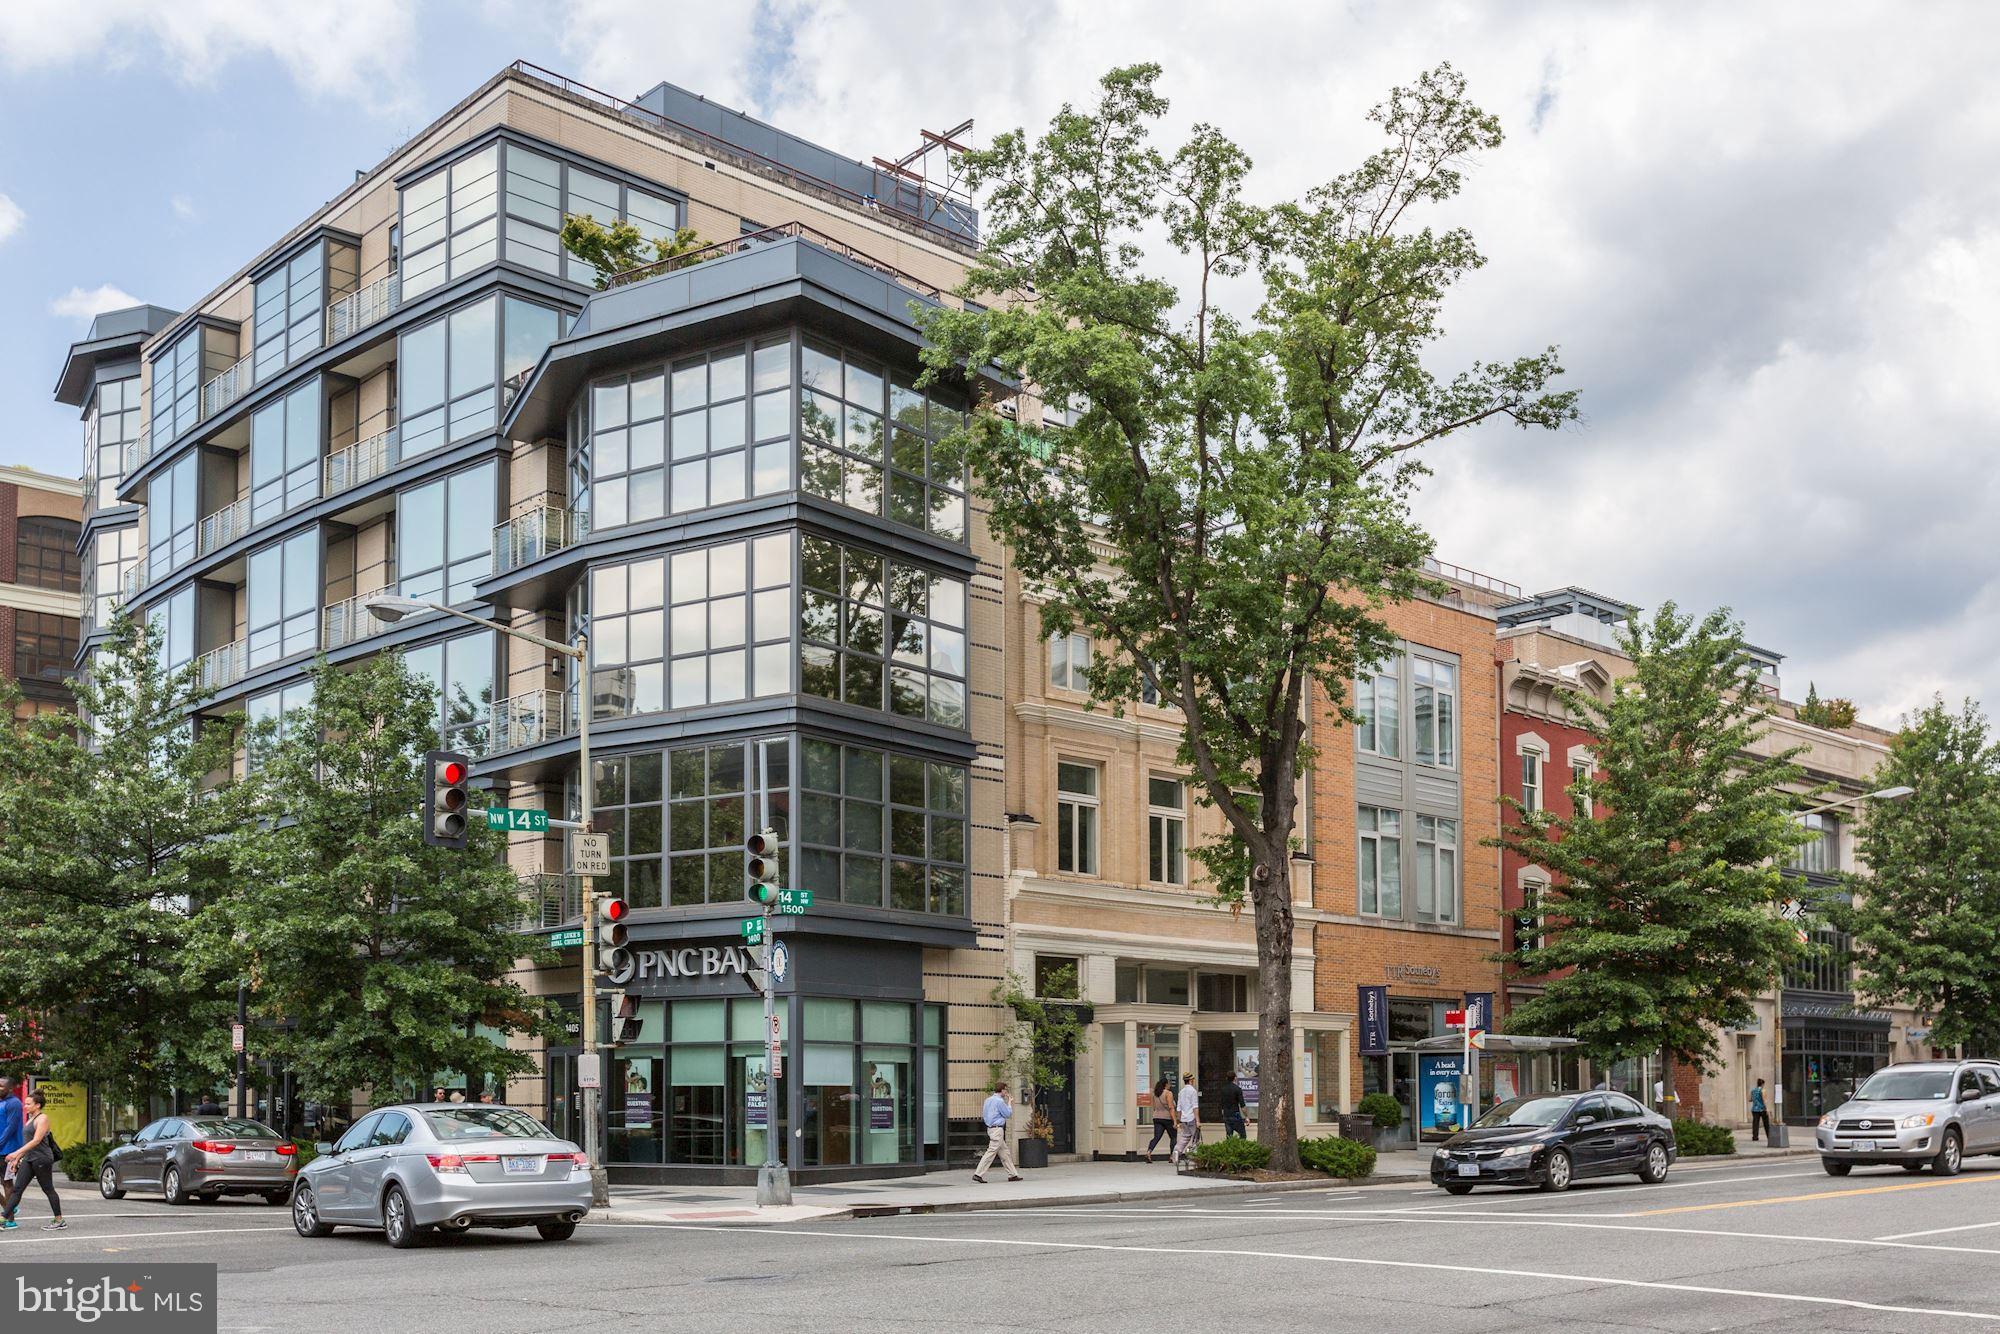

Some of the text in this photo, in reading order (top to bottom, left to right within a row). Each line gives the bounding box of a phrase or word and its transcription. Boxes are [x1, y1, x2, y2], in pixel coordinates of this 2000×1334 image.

[489, 810, 546, 829] NW 14 ST
[583, 838, 597, 847] NO
[580, 849, 602, 859] TURN
[576, 861, 607, 871] ON RED
[779, 890, 793, 903] 14
[782, 904, 804, 914] 1500
[746, 921, 753, 934] P
[747, 933, 760, 944] 1400
[636, 948, 699, 979] PNC
[565, 1023, 580, 1033] 1405
[1434, 1061, 1456, 1069] A beach
[1435, 1070, 1450, 1078] every
